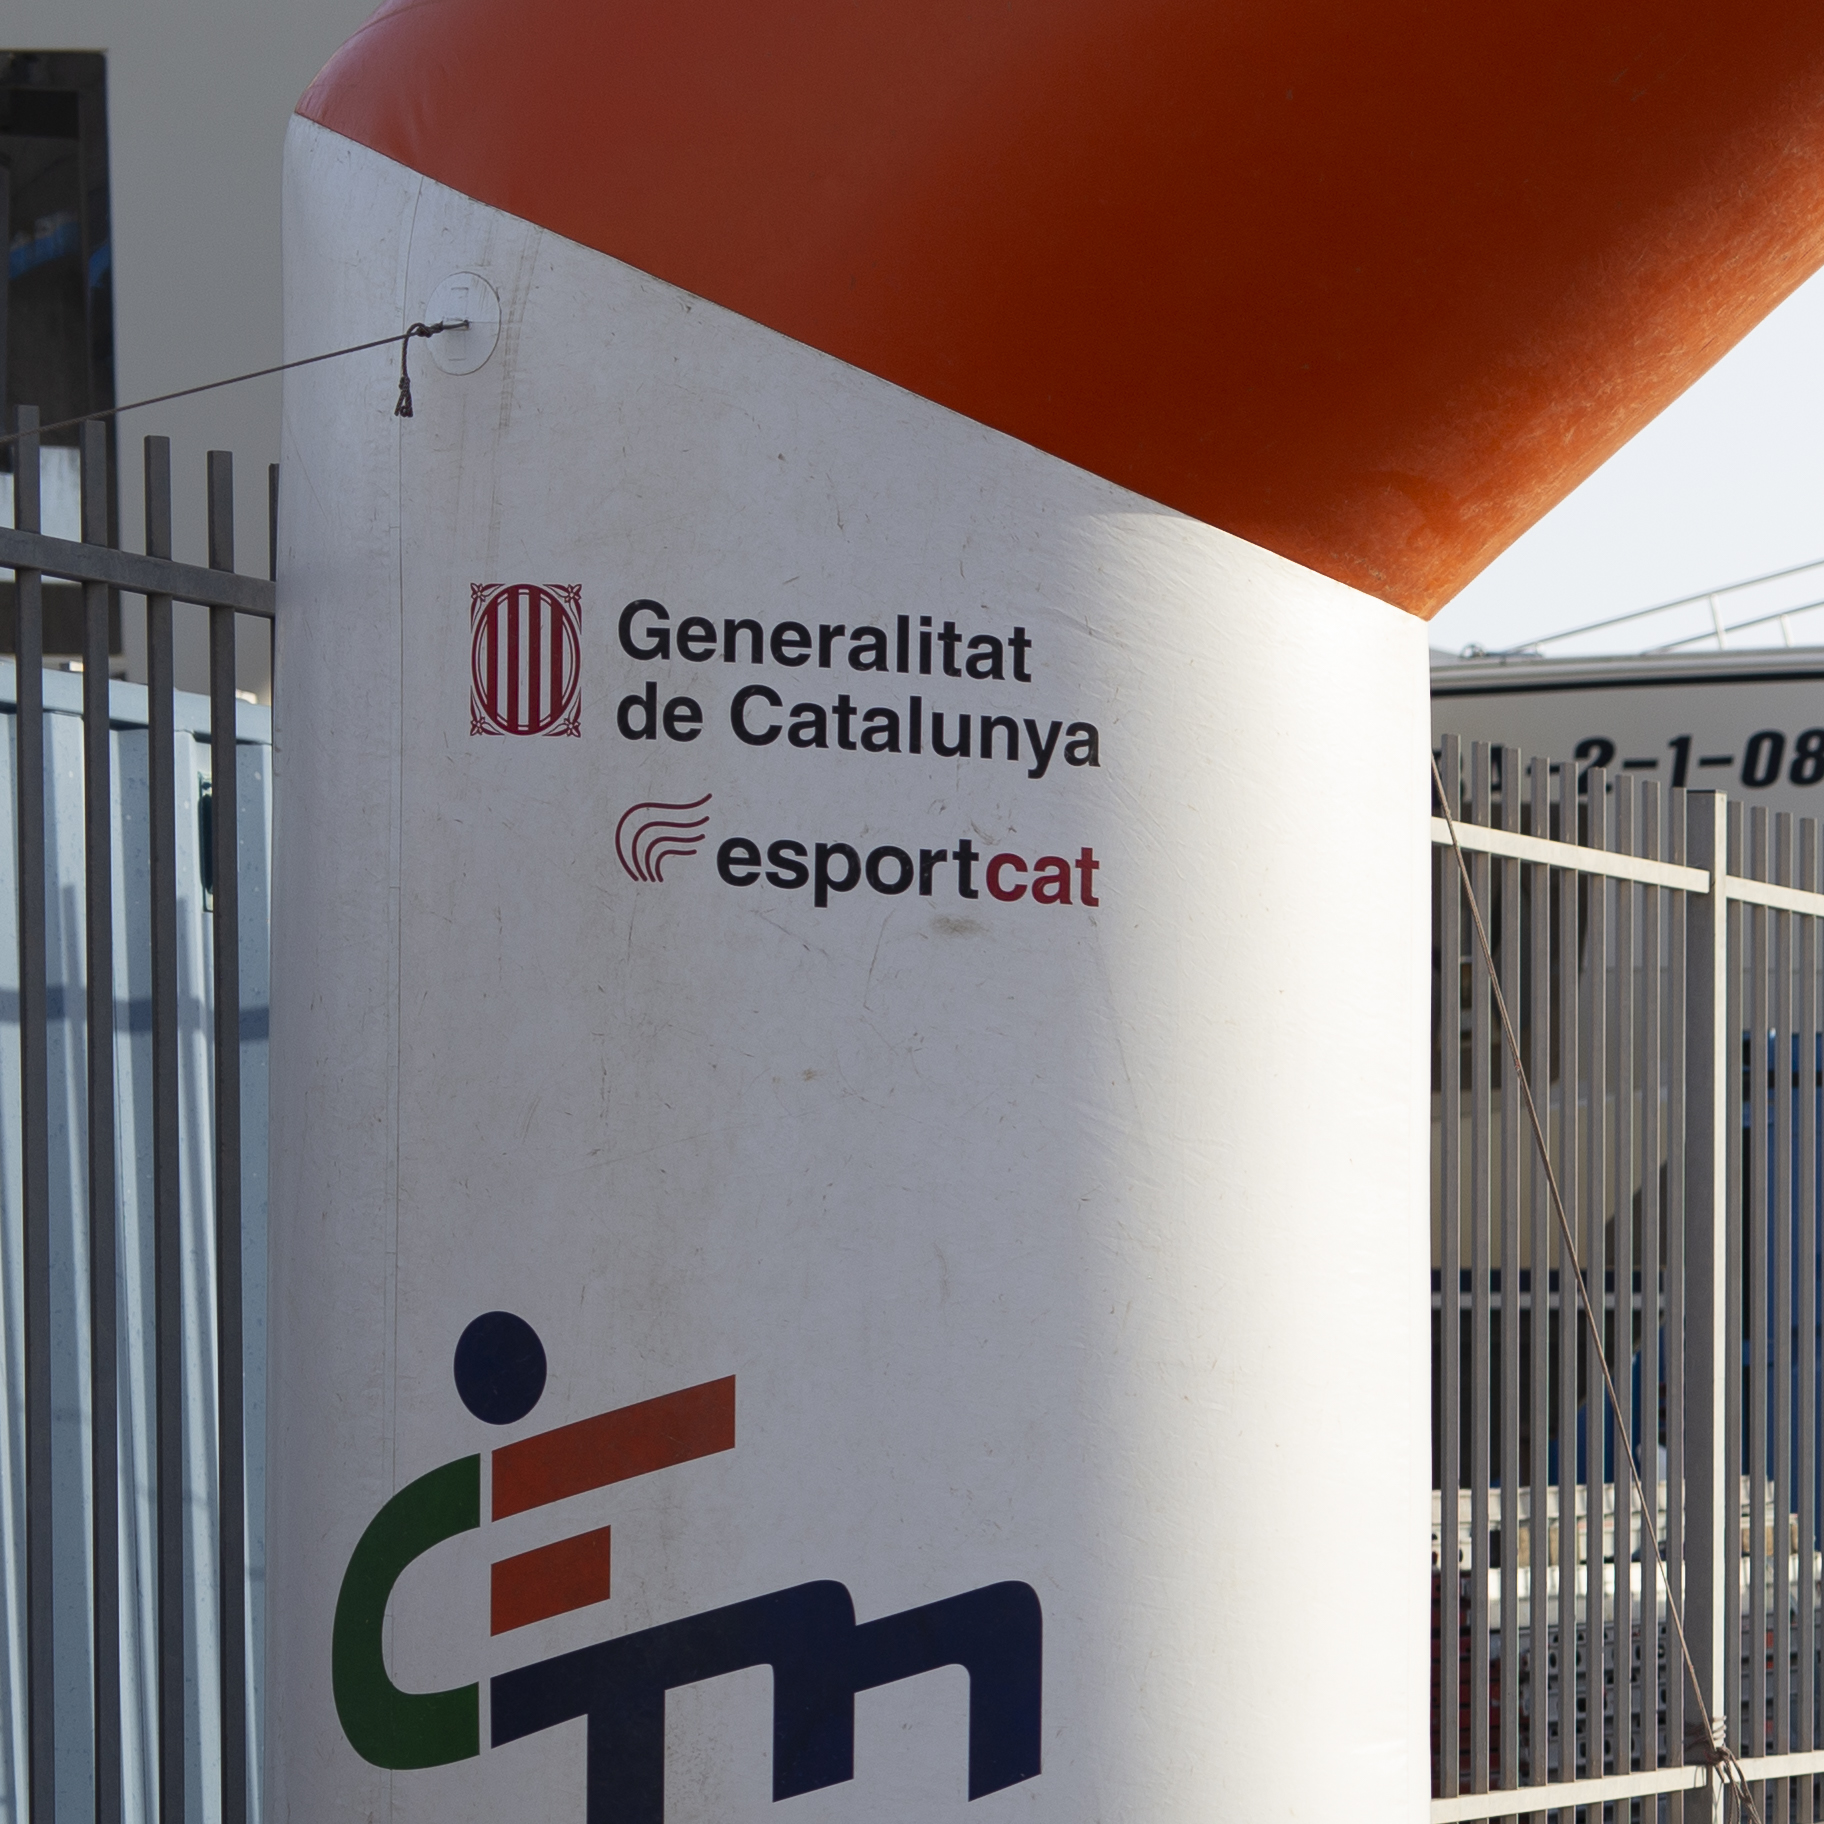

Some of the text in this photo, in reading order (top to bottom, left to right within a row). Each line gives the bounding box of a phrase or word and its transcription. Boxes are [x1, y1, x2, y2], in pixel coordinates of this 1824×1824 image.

[617, 599, 1032, 683] Generalitat
[616, 682, 1102, 779] de Catalunya
[715, 834, 1100, 908] esportcat
